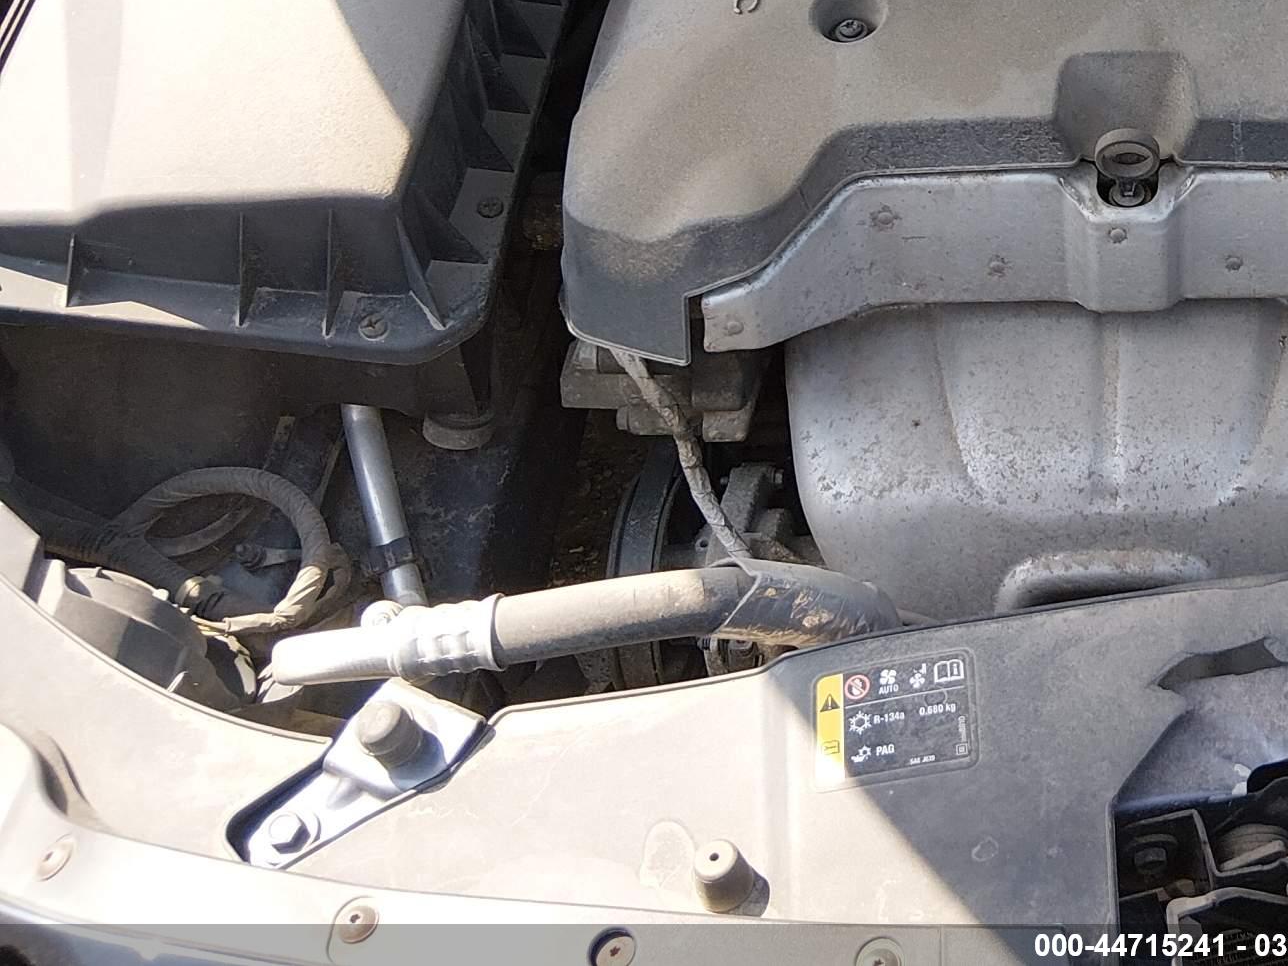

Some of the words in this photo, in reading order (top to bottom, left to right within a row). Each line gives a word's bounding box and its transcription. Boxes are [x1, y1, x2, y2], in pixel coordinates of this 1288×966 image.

[878, 684, 899, 695] AUTO
[873, 711, 905, 725] R-134a
[919, 704, 944, 717] 0.680
[945, 703, 957, 713] kg
[875, 743, 895, 756] PAG
